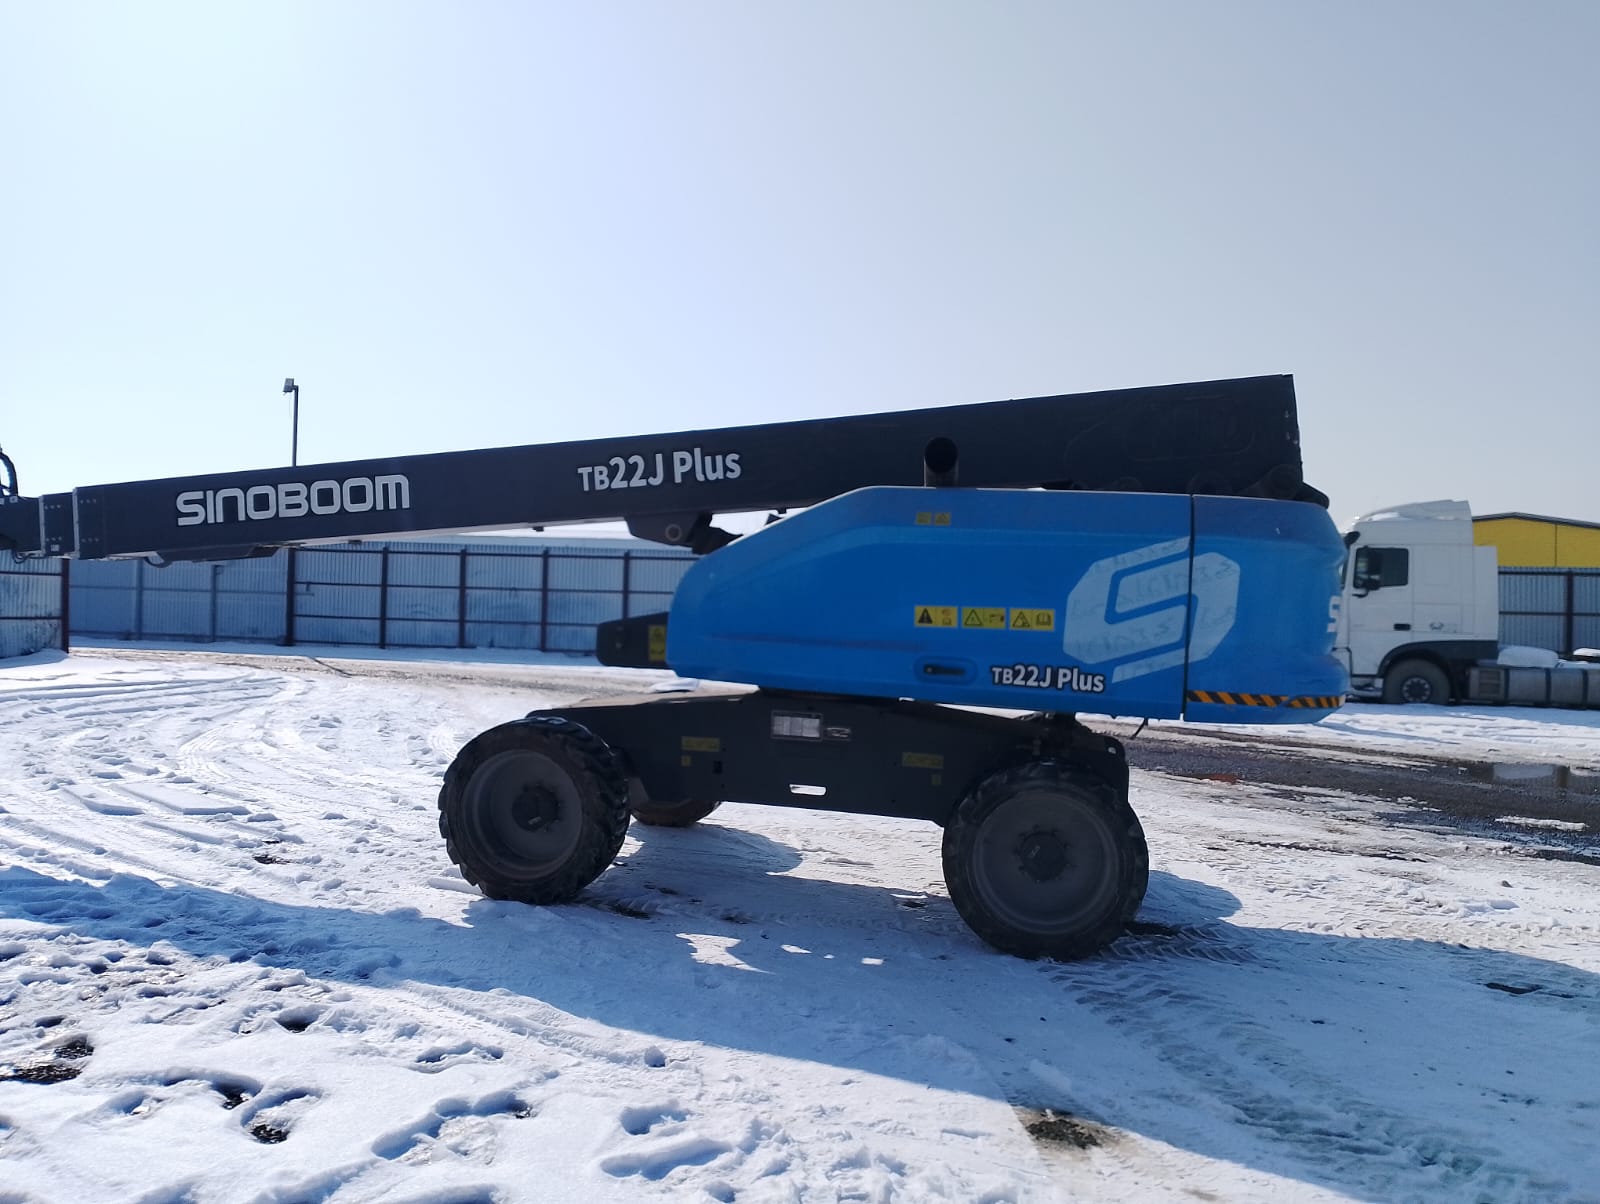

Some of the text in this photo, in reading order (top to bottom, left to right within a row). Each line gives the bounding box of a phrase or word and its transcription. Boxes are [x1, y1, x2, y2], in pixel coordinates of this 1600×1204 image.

[577, 447, 742, 492] TB22J Plus
[176, 474, 410, 526] SINOBOOM
[991, 664, 1105, 692] TB22J Plus
